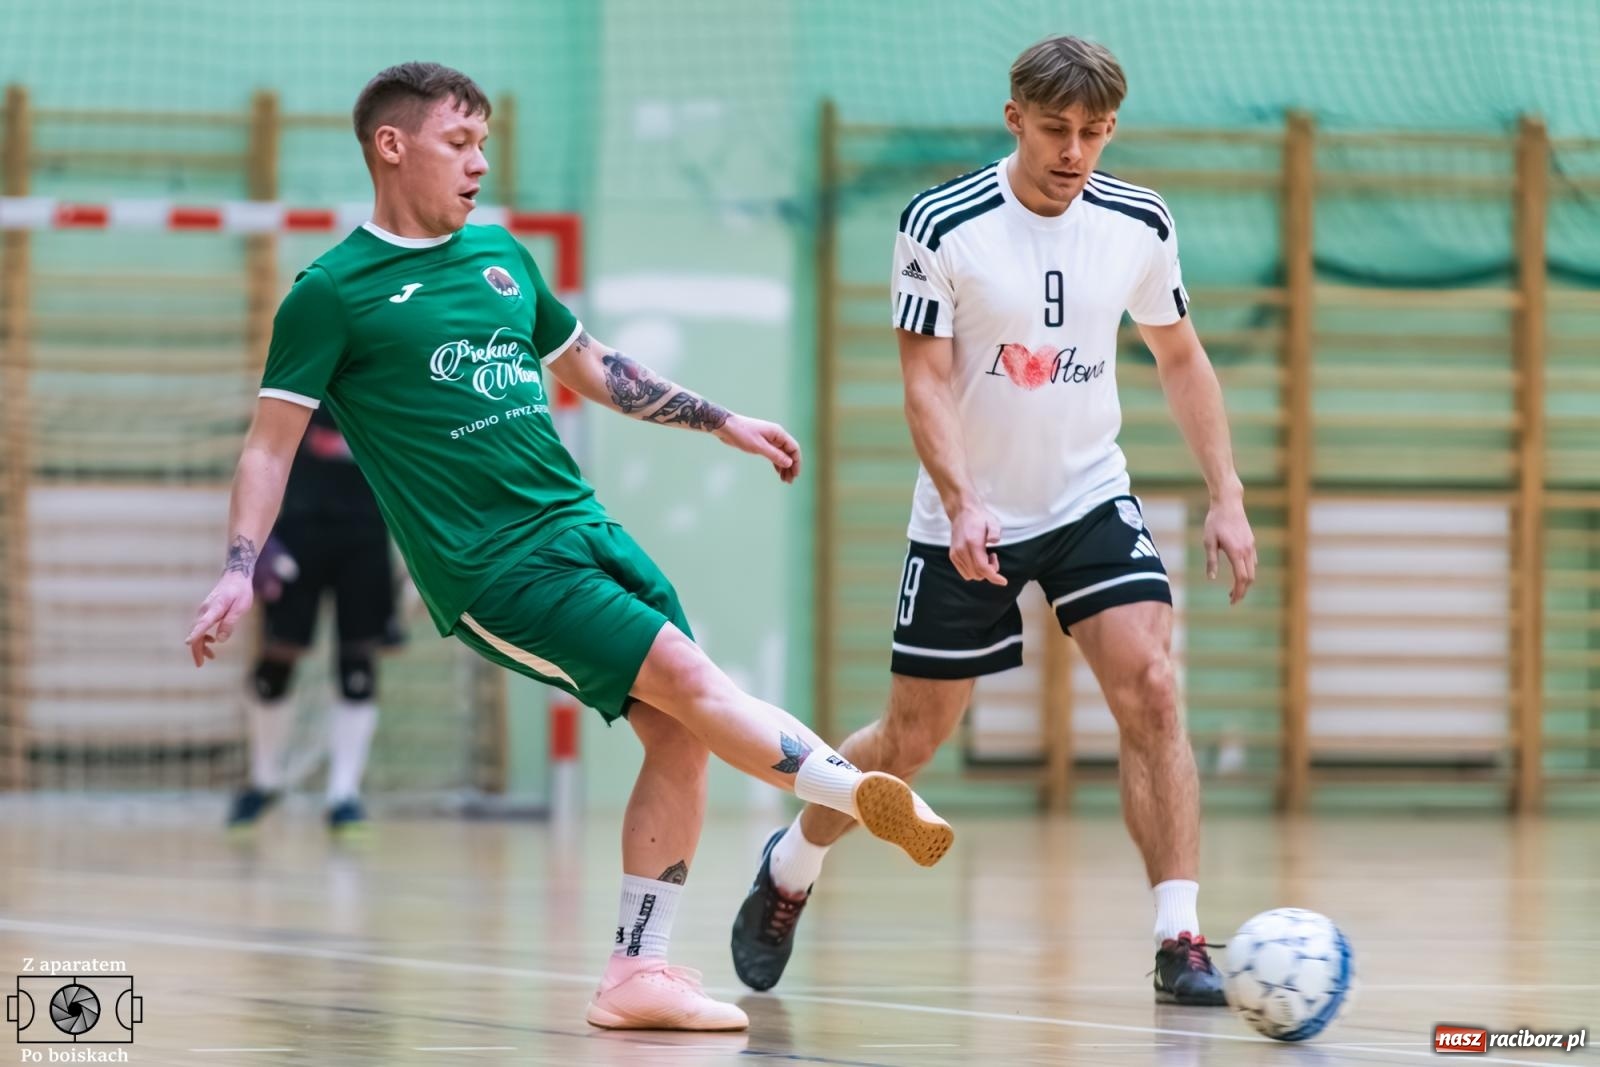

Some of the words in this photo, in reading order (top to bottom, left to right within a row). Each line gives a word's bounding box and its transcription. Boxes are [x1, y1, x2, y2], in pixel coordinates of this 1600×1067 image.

[902, 270, 927, 281] adidas
[1045, 270, 1064, 328] 9
[985, 343, 1011, 377] I
[450, 415, 499, 440] STUDIO
[899, 556, 925, 626] 9
